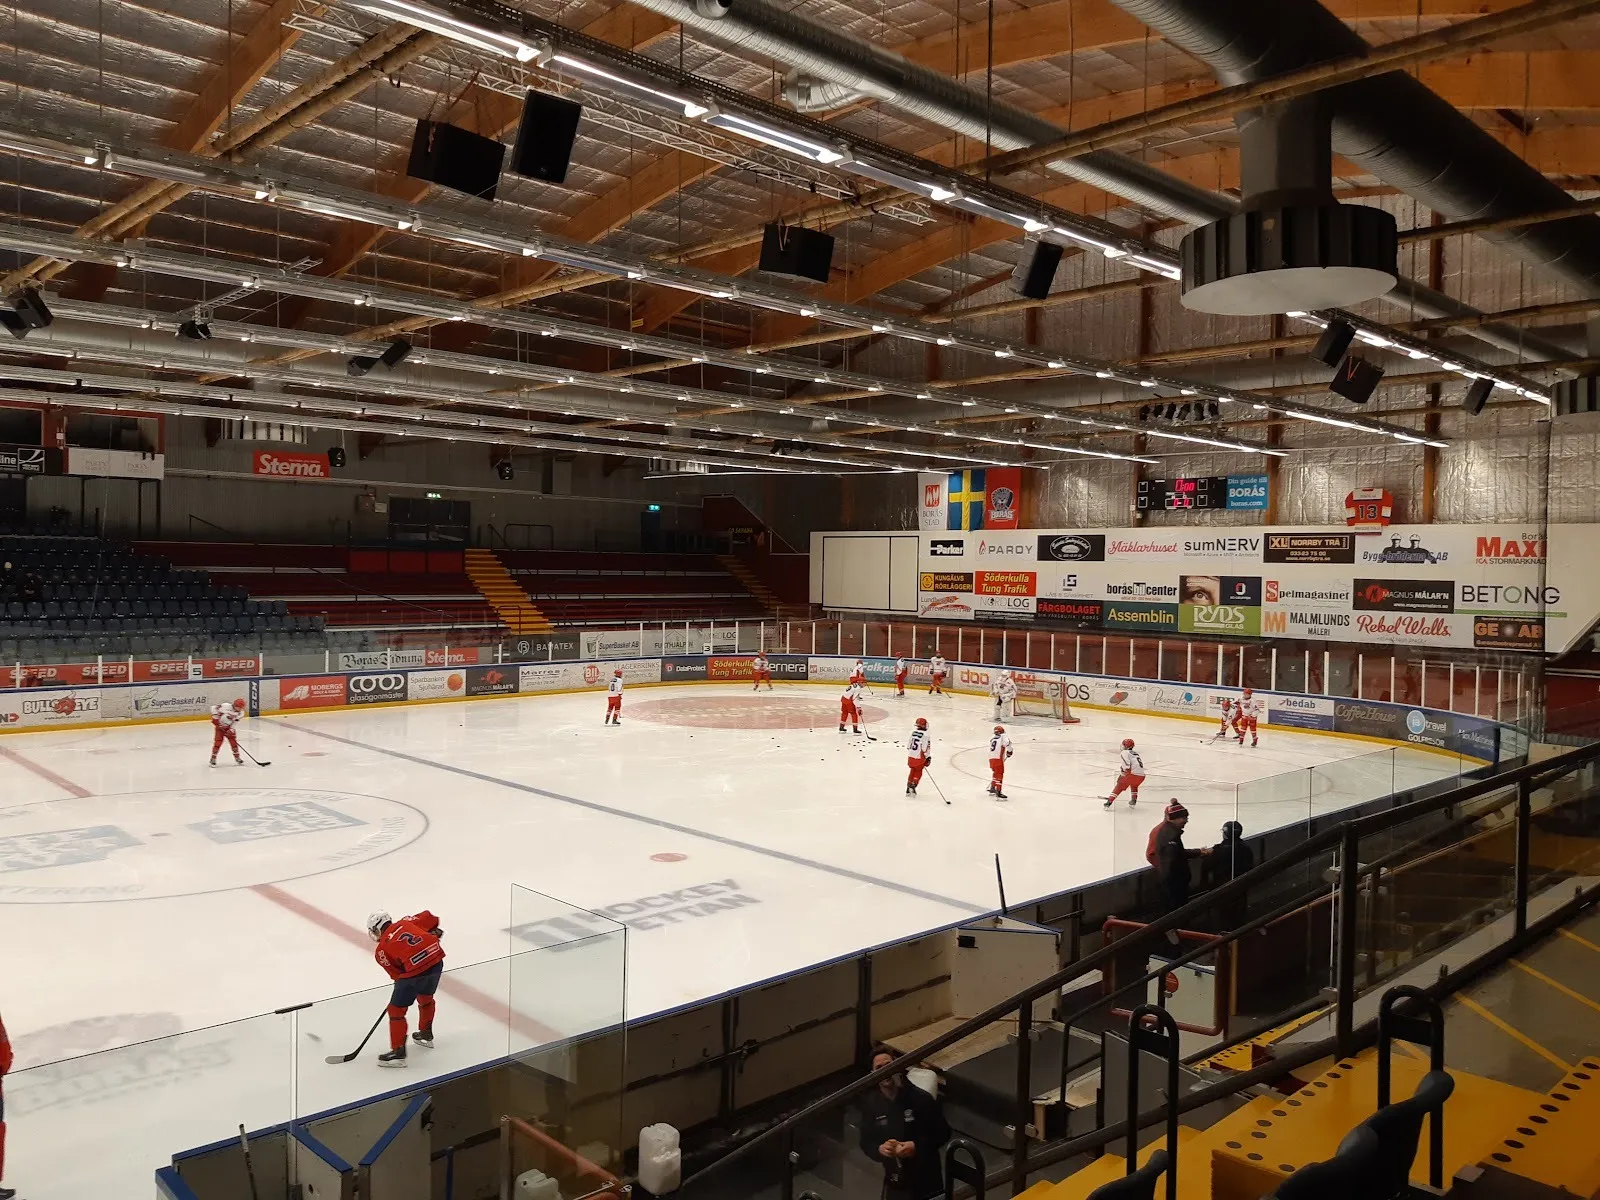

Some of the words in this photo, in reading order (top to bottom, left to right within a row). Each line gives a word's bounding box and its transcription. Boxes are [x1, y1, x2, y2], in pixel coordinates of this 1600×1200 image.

[1229, 485, 1266, 497] BORÅS
[922, 509, 943, 518] BORÅS
[1358, 505, 1377, 520] 13
[1108, 540, 1179, 554] Mäklarhuset
[1184, 538, 1260, 551] sumNERV
[1291, 538, 1322, 546] NORRBY
[1324, 537, 1341, 546] TRÄ
[1476, 536, 1547, 557] MAXI
[936, 544, 964, 555] Parker
[934, 573, 965, 581] KUNGÄLVS
[984, 572, 1029, 583] Söderkulla
[934, 582, 972, 590] RÖRLÄGGERI
[981, 583, 1001, 594] Tung
[1003, 583, 1028, 594] Trafik
[1383, 590, 1414, 598] MAGNUS
[1461, 585, 1560, 604] BETONG
[1038, 602, 1100, 615] FÄRGBOLAGET
[1193, 605, 1245, 623] RYDS
[1107, 608, 1175, 624] Assemblin
[1289, 611, 1350, 627] MALMLUNDS
[1307, 626, 1331, 636] MÅLERI
[1356, 614, 1402, 635] Rebel
[1402, 616, 1451, 637] Walls
[1474, 622, 1499, 636] GE
[599, 641, 631, 650] SuperBasket
[631, 640, 640, 648] AB
[215, 659, 255, 670] SPEED
[676, 664, 706, 672] DataProtect
[819, 665, 841, 673] BORÅS
[711, 668, 730, 677] Tung
[731, 667, 753, 676] Trafik
[151, 697, 195, 707] SuperBasket
[195, 696, 207, 704] AB
[1286, 698, 1316, 709] bedab
[1425, 720, 1447, 732] travel
[990, 740, 997, 752] 9
[625, 893, 764, 932] ETTAN
[396, 931, 424, 947] 2
